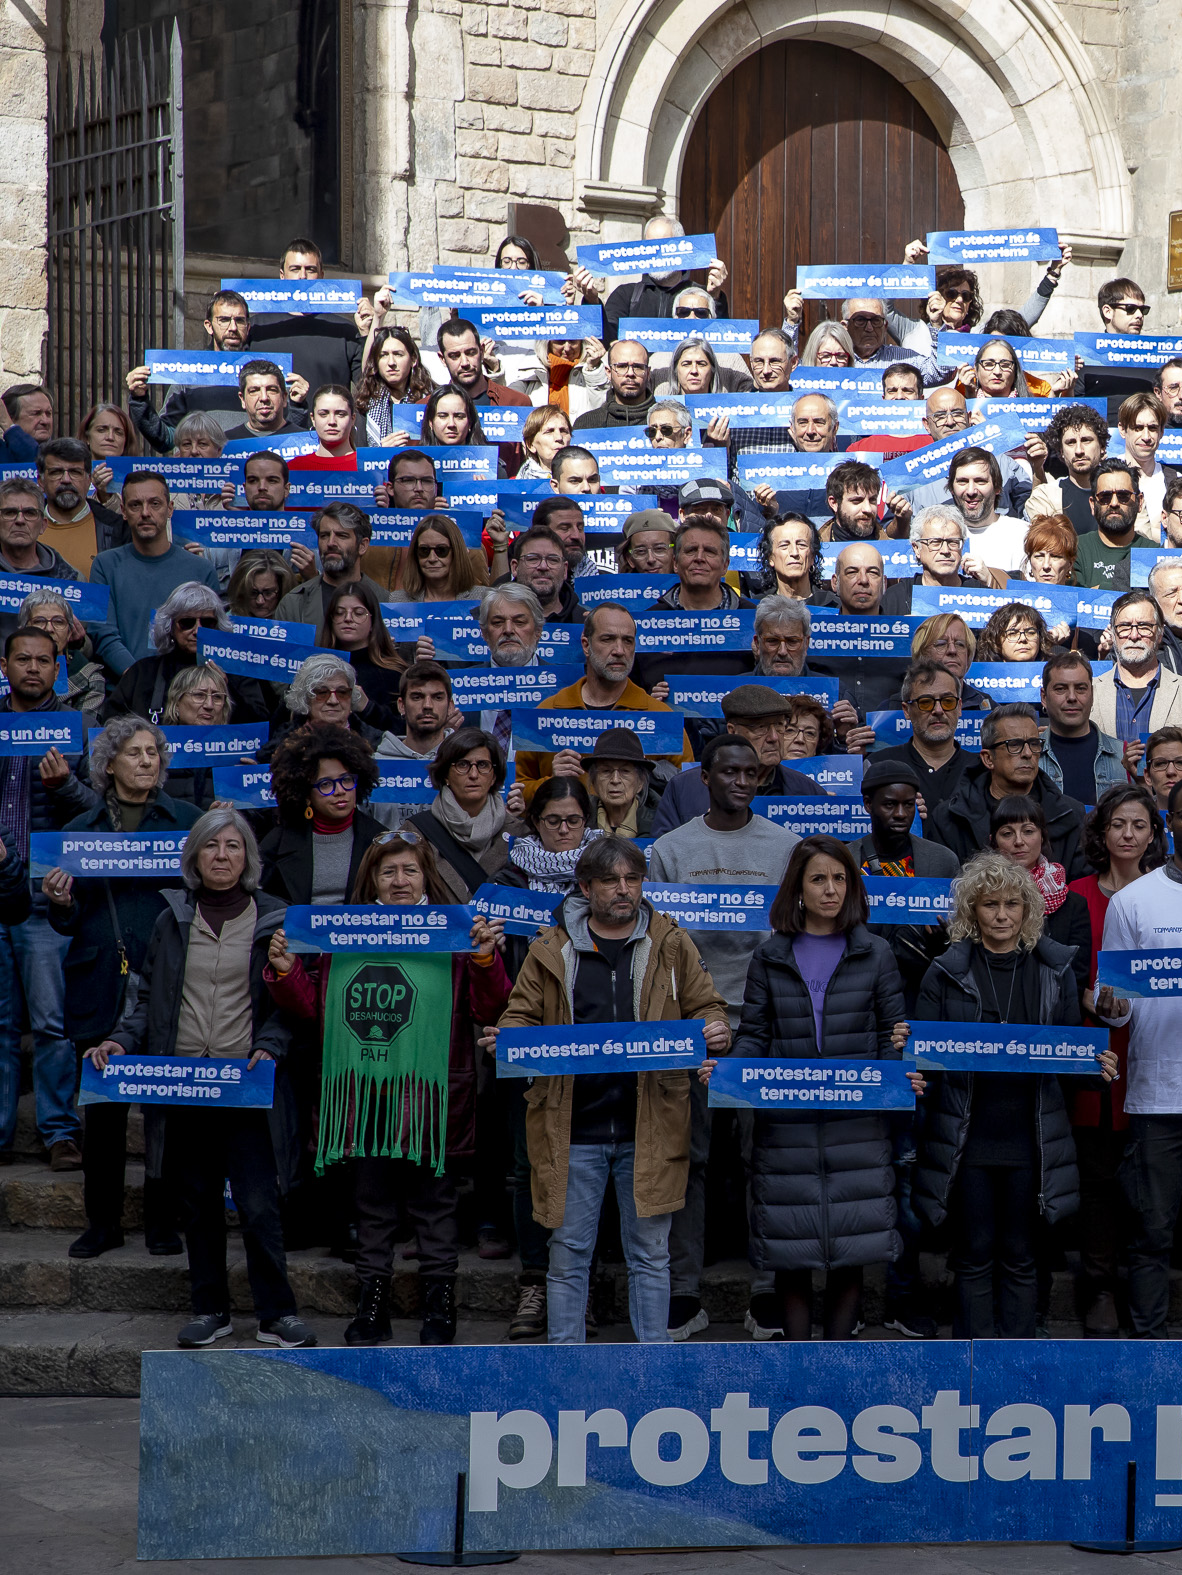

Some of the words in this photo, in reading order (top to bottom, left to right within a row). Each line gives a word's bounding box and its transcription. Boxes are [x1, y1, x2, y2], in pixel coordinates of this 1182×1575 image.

[949, 234, 1009, 248] protestar
[1009, 232, 1024, 244] no
[1027, 228, 1040, 244] és
[598, 244, 660, 261] protestar
[661, 242, 676, 255] no
[678, 239, 693, 253] és
[961, 247, 1029, 259] terrorisme
[612, 256, 682, 271] terrorisme
[410, 279, 472, 291] protestar
[474, 281, 489, 291] no
[491, 281, 506, 292] és
[804, 276, 866, 289] protestar
[867, 275, 882, 287] és
[883, 278, 900, 287] un
[902, 274, 929, 288] dret
[422, 292, 493, 305] terrorisme
[481, 311, 545, 324] protestar
[546, 312, 562, 321] no
[564, 309, 579, 322] és
[494, 324, 567, 336] terrorisme
[625, 329, 686, 342] protestar
[707, 331, 724, 341] un
[726, 329, 752, 341] dret
[1096, 339, 1158, 351] protestar
[1158, 342, 1173, 351] no
[152, 362, 218, 374] protestar
[219, 362, 234, 374] és
[760, 404, 776, 415] és
[848, 406, 912, 417] protestar
[987, 403, 1050, 415] protestar
[905, 438, 967, 471] protestar
[968, 431, 984, 446] no
[986, 424, 1001, 439] és
[599, 454, 666, 468] protestar
[668, 457, 684, 466] no
[686, 452, 702, 466] és
[204, 464, 222, 473] no
[612, 468, 689, 480] terrorisme
[745, 465, 807, 478] protestar
[808, 465, 824, 476] és
[196, 516, 268, 529] protestar
[269, 518, 286, 528] no
[289, 515, 306, 528] és
[211, 531, 291, 543] terrorisme
[581, 586, 648, 601] protestar
[648, 586, 662, 599] és
[639, 632, 725, 645] terrorisme
[203, 643, 268, 664] protestar
[270, 654, 286, 668] és
[452, 691, 541, 704] terrorisme
[637, 718, 656, 731] és
[34, 726, 71, 740] dret
[229, 737, 260, 751] dret
[816, 769, 852, 782] dret
[767, 802, 849, 819] protestar
[62, 839, 150, 855] protestar
[154, 839, 174, 850] no
[310, 913, 400, 928] protestar
[402, 914, 425, 925] no
[429, 910, 447, 925] és
[513, 904, 552, 923] dret
[329, 931, 430, 945] terrorisme
[350, 983, 406, 1009] STOP
[349, 1011, 402, 1023] DESAHUCIOS
[360, 1047, 388, 1062] PAH
[507, 1043, 599, 1062] protestar
[602, 1040, 624, 1055] és
[626, 1042, 651, 1055] un
[654, 1037, 693, 1052] dret
[914, 1040, 1003, 1057] protestar
[1005, 1040, 1027, 1054] és
[1029, 1043, 1052, 1055] un
[1055, 1041, 1096, 1057] dret
[103, 1064, 193, 1078] protestar
[195, 1067, 218, 1079] no
[220, 1064, 241, 1080] és
[742, 1067, 832, 1084] protestar
[835, 1068, 857, 1081] no
[860, 1065, 881, 1081] és
[119, 1082, 221, 1099] terrorisme
[760, 1086, 863, 1101] terrorisme
[469, 1390, 1131, 1512] protestar
